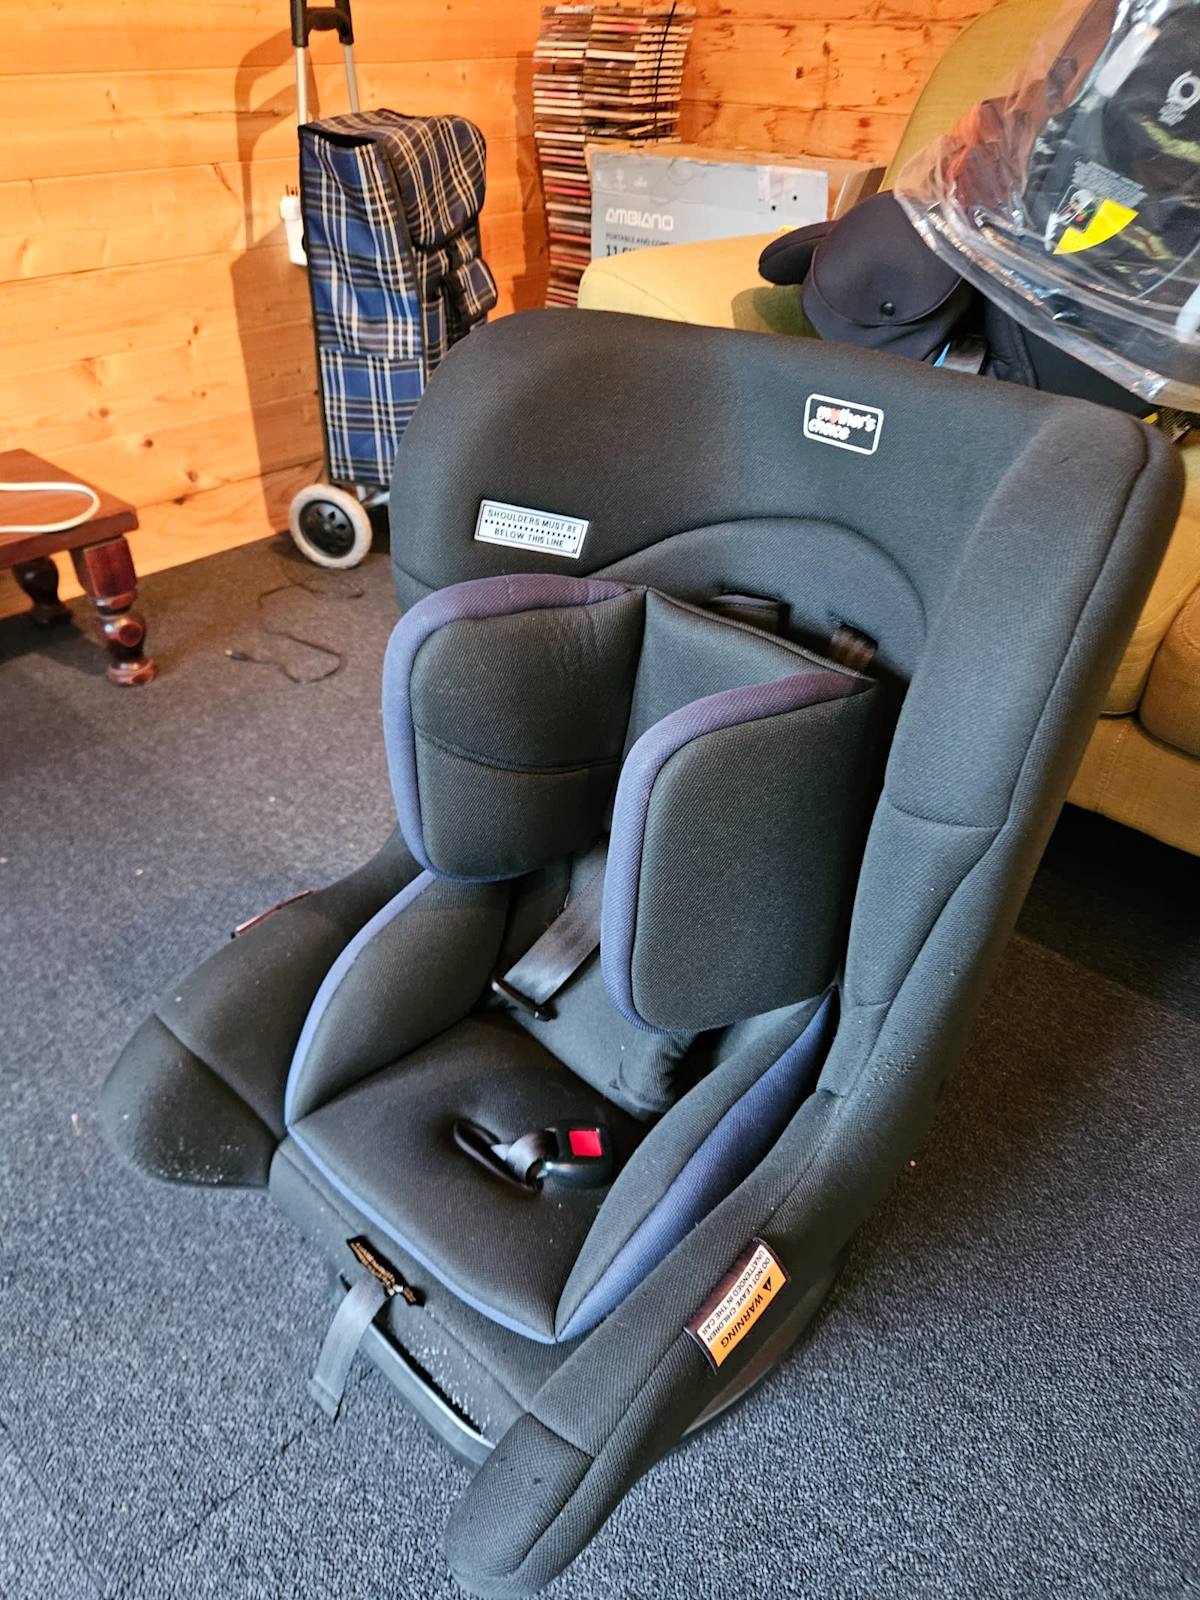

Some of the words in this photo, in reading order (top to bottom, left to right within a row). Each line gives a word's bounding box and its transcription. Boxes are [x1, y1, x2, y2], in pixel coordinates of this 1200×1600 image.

[605, 208, 674, 231] AMBIANO
[487, 509, 540, 526] SHOULDERS
[542, 520, 565, 530] MUST
[567, 525, 577, 533] BE
[494, 528, 525, 539] BELOW
[528, 534, 544, 544] THIS
[546, 538, 564, 548] LINE
[732, 1249, 765, 1297] UNATTENDED
[762, 1257, 771, 1270] DO
[752, 1270, 763, 1286] NOT
[727, 1295, 734, 1304] IN
[736, 1284, 754, 1308] LEAVE
[714, 1304, 727, 1320] THE
[720, 1294, 764, 1348] WARNING
[702, 1318, 716, 1335] CAR
[707, 1306, 737, 1343] CHILDREN
